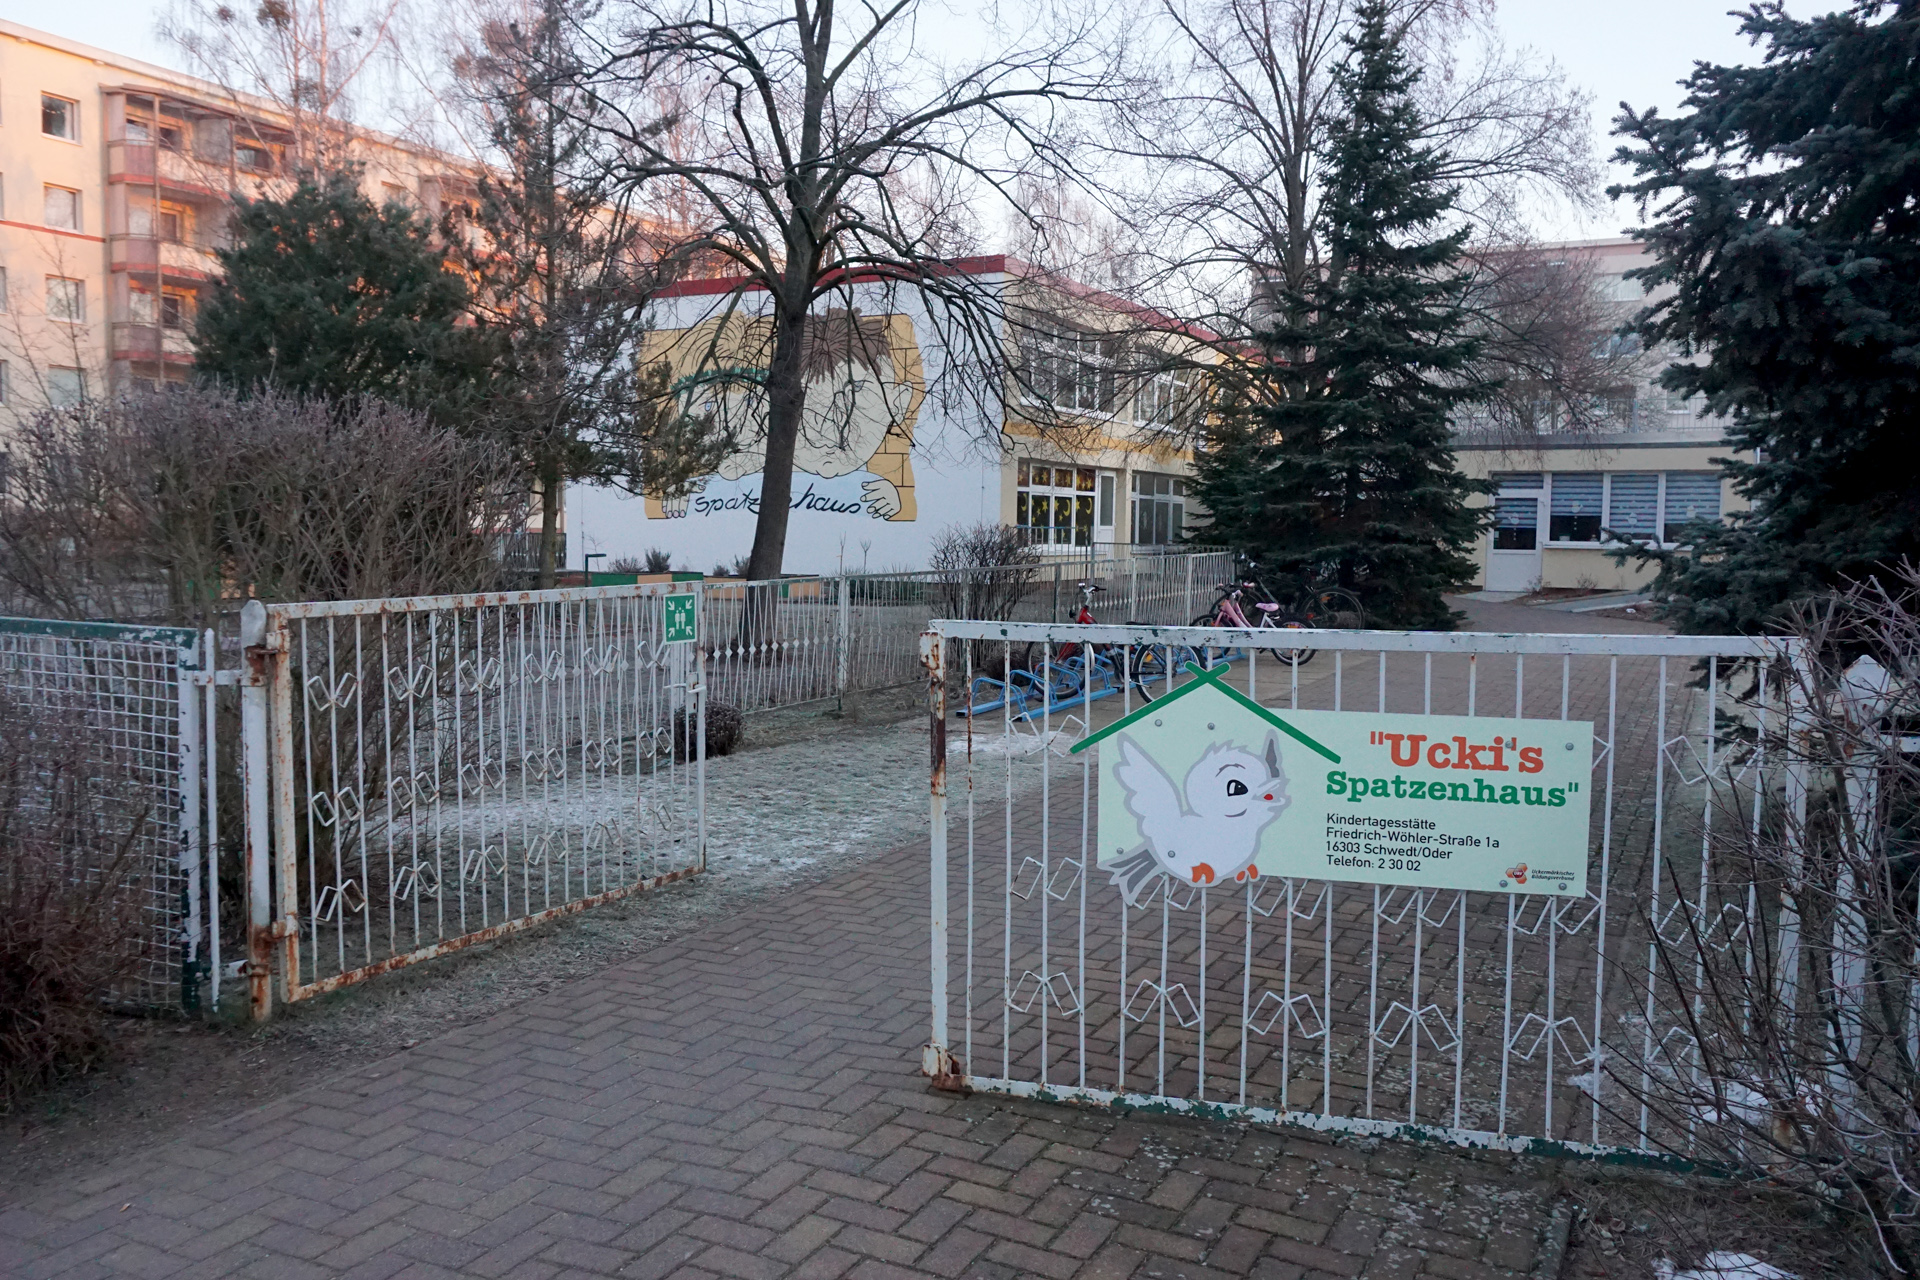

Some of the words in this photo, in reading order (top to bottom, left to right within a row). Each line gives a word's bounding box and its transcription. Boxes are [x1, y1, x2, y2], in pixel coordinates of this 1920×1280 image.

[694, 483, 862, 517] spatzhaus
[1370, 731, 1544, 773] "Ucki's
[1326, 771, 1579, 807] Spatzenhaus"
[1326, 812, 1436, 831] Kindertagesstätte
[1326, 826, 1482, 848] Friedrich-Wöhler-Straße
[1485, 836, 1500, 849] 1a
[1326, 840, 1361, 854] 16303
[1363, 842, 1454, 860] Schwedt/Oder
[1326, 854, 1375, 868] Telefon:
[1377, 857, 1386, 869] 2
[1388, 858, 1403, 871] 30
[1406, 859, 1422, 872] 02
